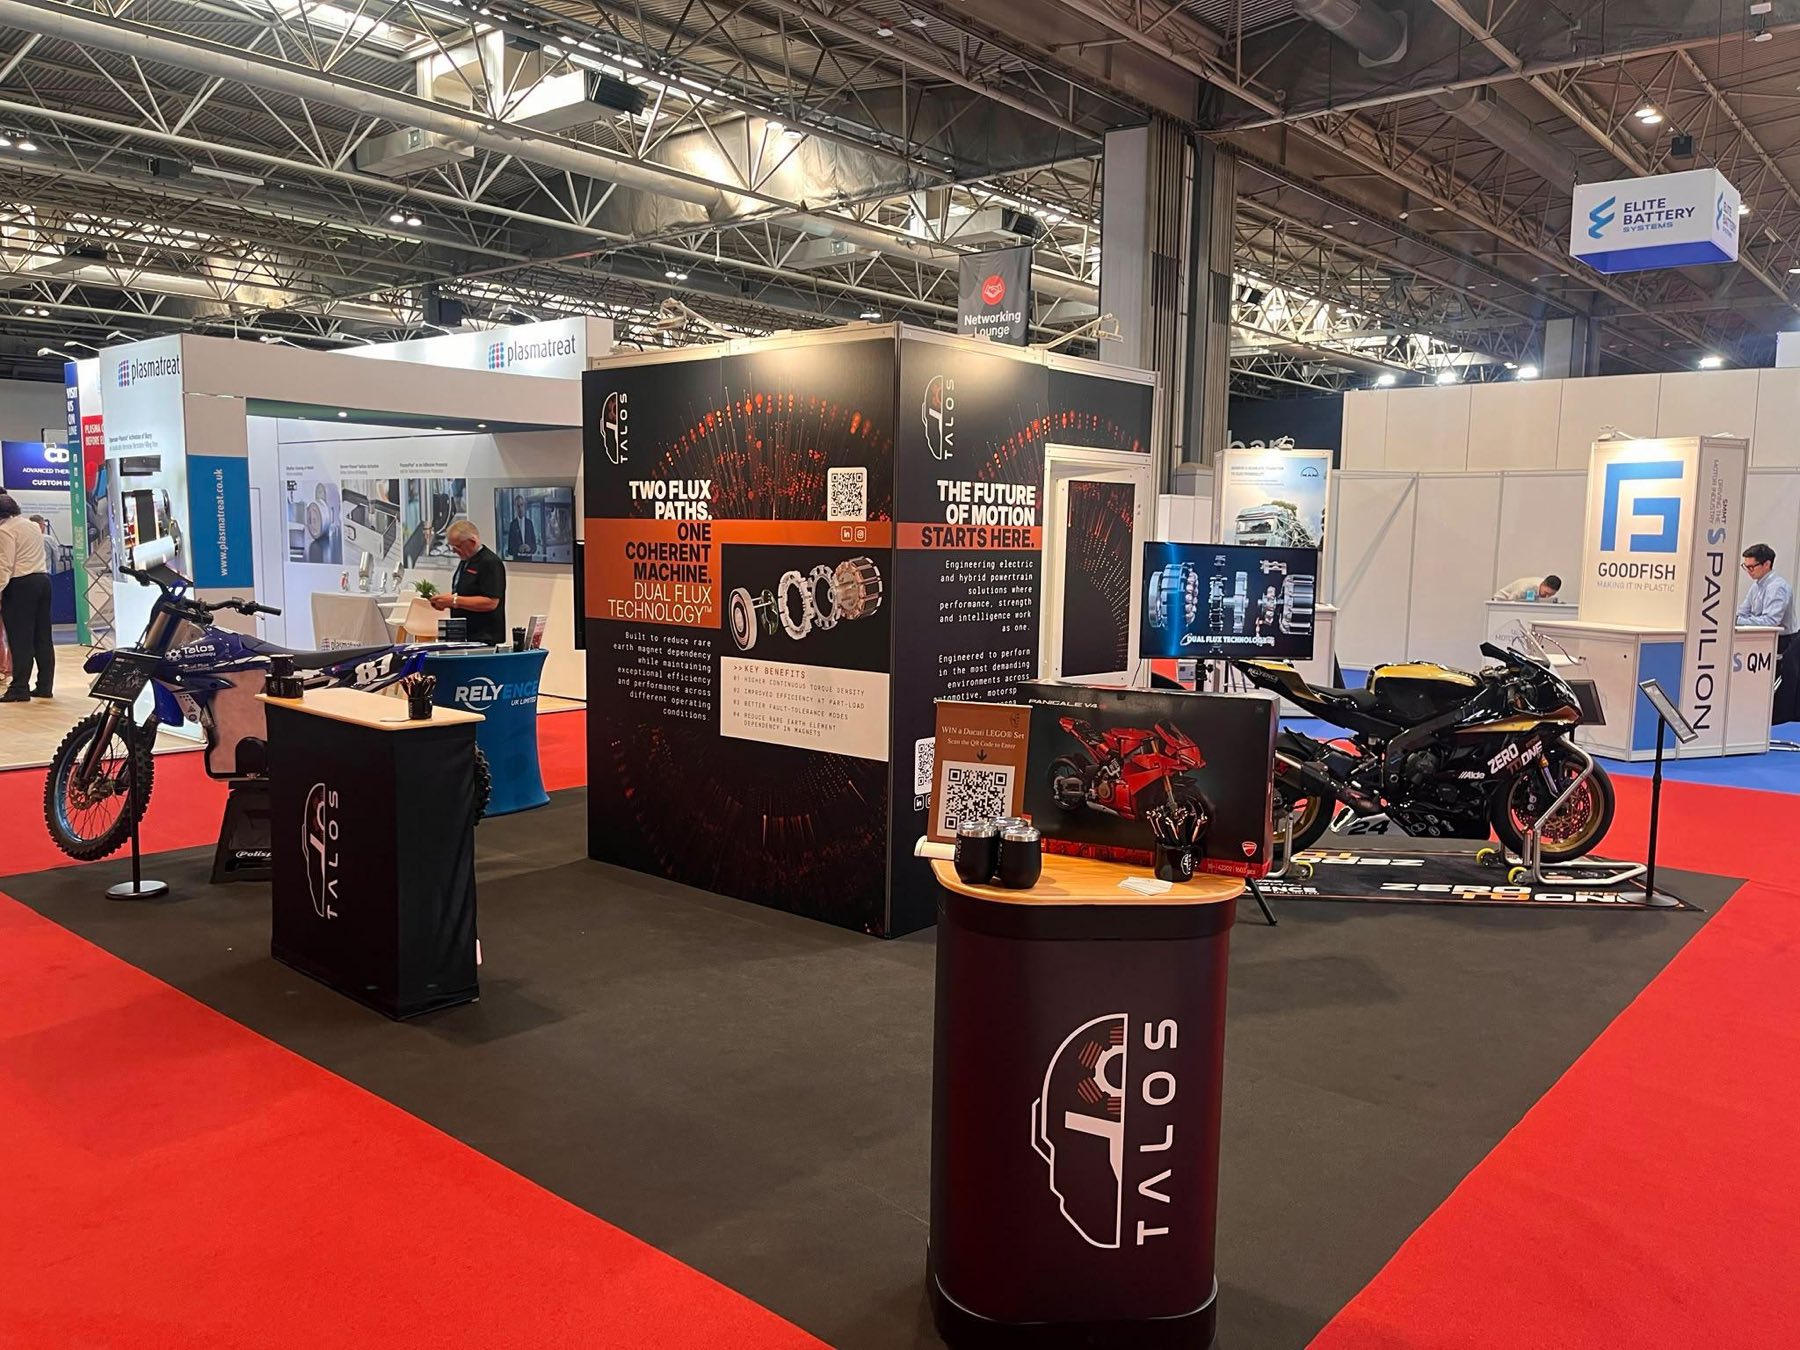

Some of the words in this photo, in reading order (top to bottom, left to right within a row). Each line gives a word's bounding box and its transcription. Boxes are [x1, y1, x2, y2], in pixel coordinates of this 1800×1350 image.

[1623, 198, 1666, 214] ELITE
[1623, 206, 1696, 225] BATTERY
[1622, 222, 1674, 232] SYSTEMS
[964, 310, 1022, 326] Networking
[974, 326, 1010, 338] Lounge
[507, 334, 576, 367] plasmatreat
[131, 354, 181, 386] plasmatreat
[66, 386, 78, 398] VISIT
[67, 400, 74, 412] US
[68, 414, 76, 425] ON
[628, 480, 666, 500] TWO
[668, 480, 712, 500] FLUX
[937, 480, 971, 502] THE
[974, 482, 1036, 506] FUTURE
[654, 501, 712, 520] PATHS.
[946, 504, 970, 525] OF
[972, 505, 1035, 526] MOTION
[213, 468, 228, 576] www.plasmatreat.co.uk
[677, 522, 712, 542] ONE
[921, 526, 987, 548] STARTS
[990, 528, 1034, 548] HERE.
[625, 542, 712, 563] COHERENT
[634, 562, 712, 584] MACHINE.
[946, 560, 996, 570] Engineering
[999, 560, 1034, 569] electric
[1598, 562, 1676, 580] GOODFISH
[940, 574, 954, 583] and
[958, 573, 986, 584] hybrid
[990, 572, 1033, 583] powertrain
[1597, 581, 1624, 590] MAKING
[1644, 583, 1675, 592] PLASTIC
[634, 582, 672, 602] DUAL
[674, 584, 712, 604] FLUX
[968, 586, 1008, 595] solutions
[1012, 586, 1033, 594] where
[940, 600, 994, 611] performance,
[998, 598, 1032, 608] strength
[940, 614, 954, 623] and
[958, 612, 1011, 624] intelligence
[1014, 610, 1032, 619] work
[1002, 624, 1010, 632] as
[1014, 624, 1030, 632] one.
[625, 631, 646, 640] Built
[650, 634, 659, 642] to
[663, 634, 689, 646] reduce
[694, 638, 712, 648] rare
[1693, 552, 1724, 730] PAVILION
[613, 642, 634, 651] earth
[638, 645, 663, 655] magnet
[667, 646, 712, 660] dependency
[938, 652, 984, 665] Engineered
[988, 650, 998, 659] to
[1001, 648, 1031, 660] perform
[638, 656, 659, 666] while
[662, 660, 712, 674] maintaining
[938, 668, 948, 677] in
[952, 666, 966, 675] the
[970, 664, 988, 673] most
[992, 660, 1030, 672] demanding
[1747, 652, 1772, 673] QM
[618, 667, 663, 678] exceptional
[667, 672, 711, 686] efficiency
[764, 667, 806, 679] BENEFITS
[947, 676, 1001, 689] environments
[1004, 672, 1030, 682] across
[455, 680, 538, 702] RELYENCE
[618, 678, 630, 686] and
[634, 680, 680, 692] performance
[684, 687, 712, 696] across
[744, 676, 766, 685] HIGHER
[770, 680, 806, 690] CONTINUOUS
[810, 684, 833, 694] TORQUE
[836, 687, 864, 696] DENSITY
[630, 690, 667, 702] different
[672, 696, 711, 710] operating
[744, 688, 773, 698] IMPROVED
[776, 692, 814, 703] EFFICIENCY
[829, 699, 864, 710] PART-LOAD
[1028, 698, 1083, 708] PANIGALE
[663, 708, 710, 720] conditions.
[744, 700, 766, 709] BETTER
[769, 703, 824, 718] FAULT-TOLERANCE
[828, 712, 848, 720] MODES
[744, 712, 766, 721] REDUCE
[770, 716, 783, 724] RARE
[787, 718, 806, 728] EARTH
[810, 722, 836, 731] ELEMENT
[744, 720, 780, 730] DEPENDENCY
[794, 728, 821, 737] MAGNETS
[942, 726, 957, 734] WIN
[1013, 731, 1025, 740] Set
[980, 740, 994, 748] Code
[1520, 740, 1543, 766] ONE
[1487, 743, 1520, 775] ZERO
[1347, 820, 1391, 836] 24
[1379, 882, 1532, 895] ZERO
